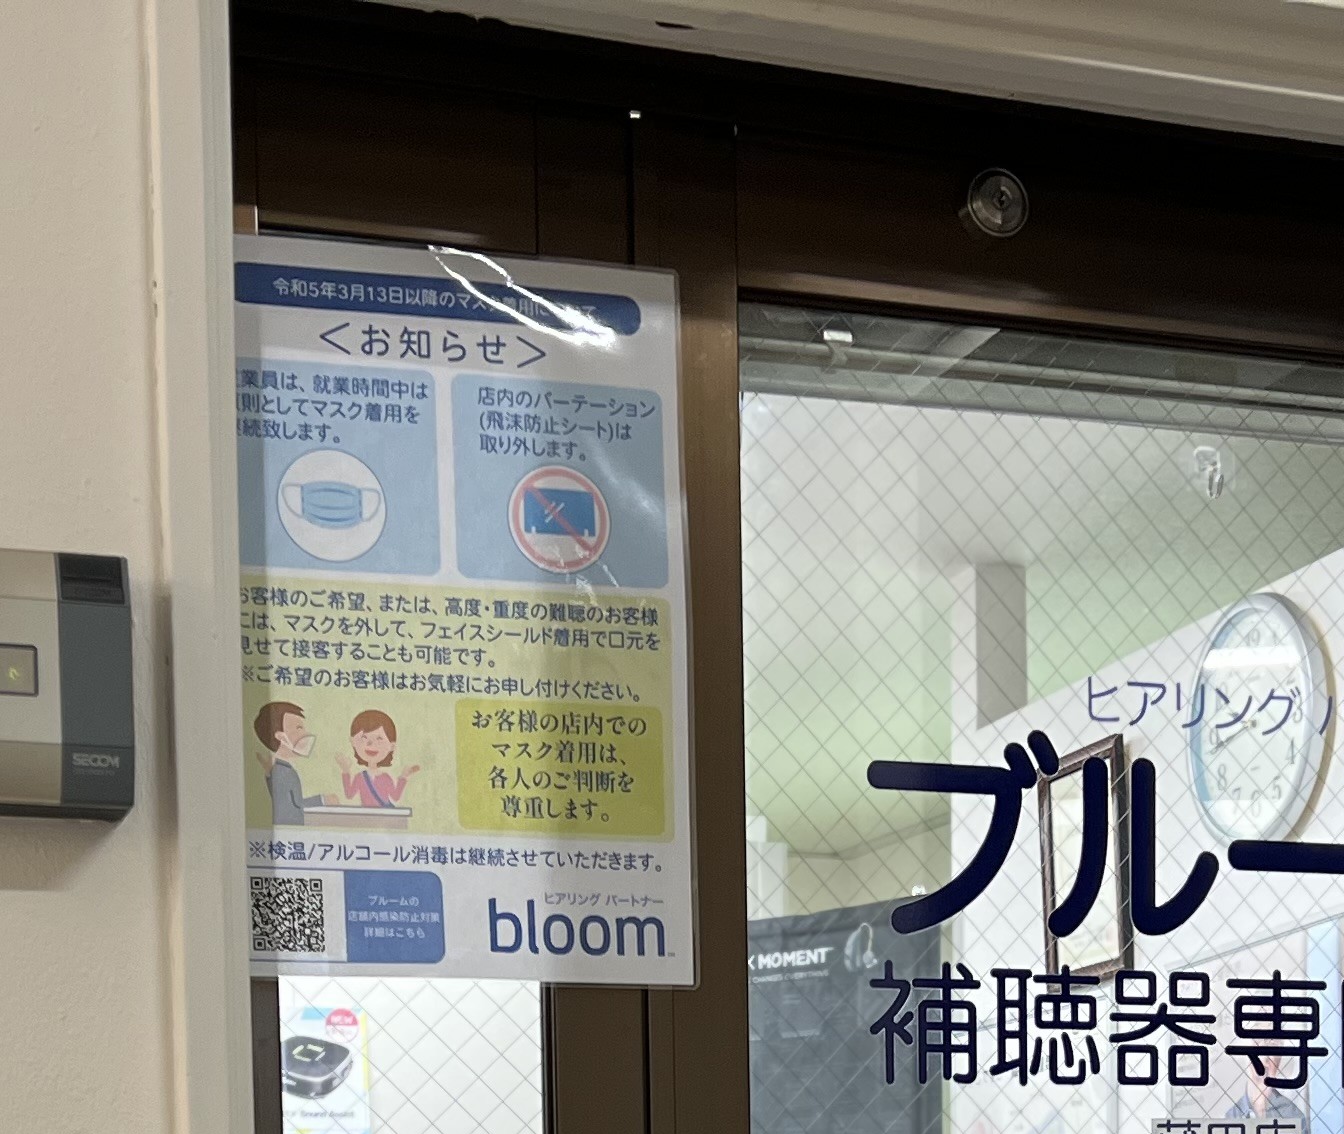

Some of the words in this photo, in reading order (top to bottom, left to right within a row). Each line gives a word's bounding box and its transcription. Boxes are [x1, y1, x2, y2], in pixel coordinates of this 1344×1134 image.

[237, 368, 429, 400] 業員は、就業時間中は
[237, 392, 421, 424] 則としてマスク着用を
[477, 386, 656, 418] 店内のパーテーション
[237, 418, 341, 444] 続致します。
[479, 433, 587, 462] 取り外します。
[1086, 676, 1302, 737] ヒアリング
[471, 708, 647, 737] お客様の店内での
[491, 739, 627, 766] マスク着用は、
[487, 765, 635, 794] 各人のご判断を
[500, 794, 610, 823] 尊重します。
[487, 897, 666, 958] bloom
[757, 946, 829, 970] MOMENT
